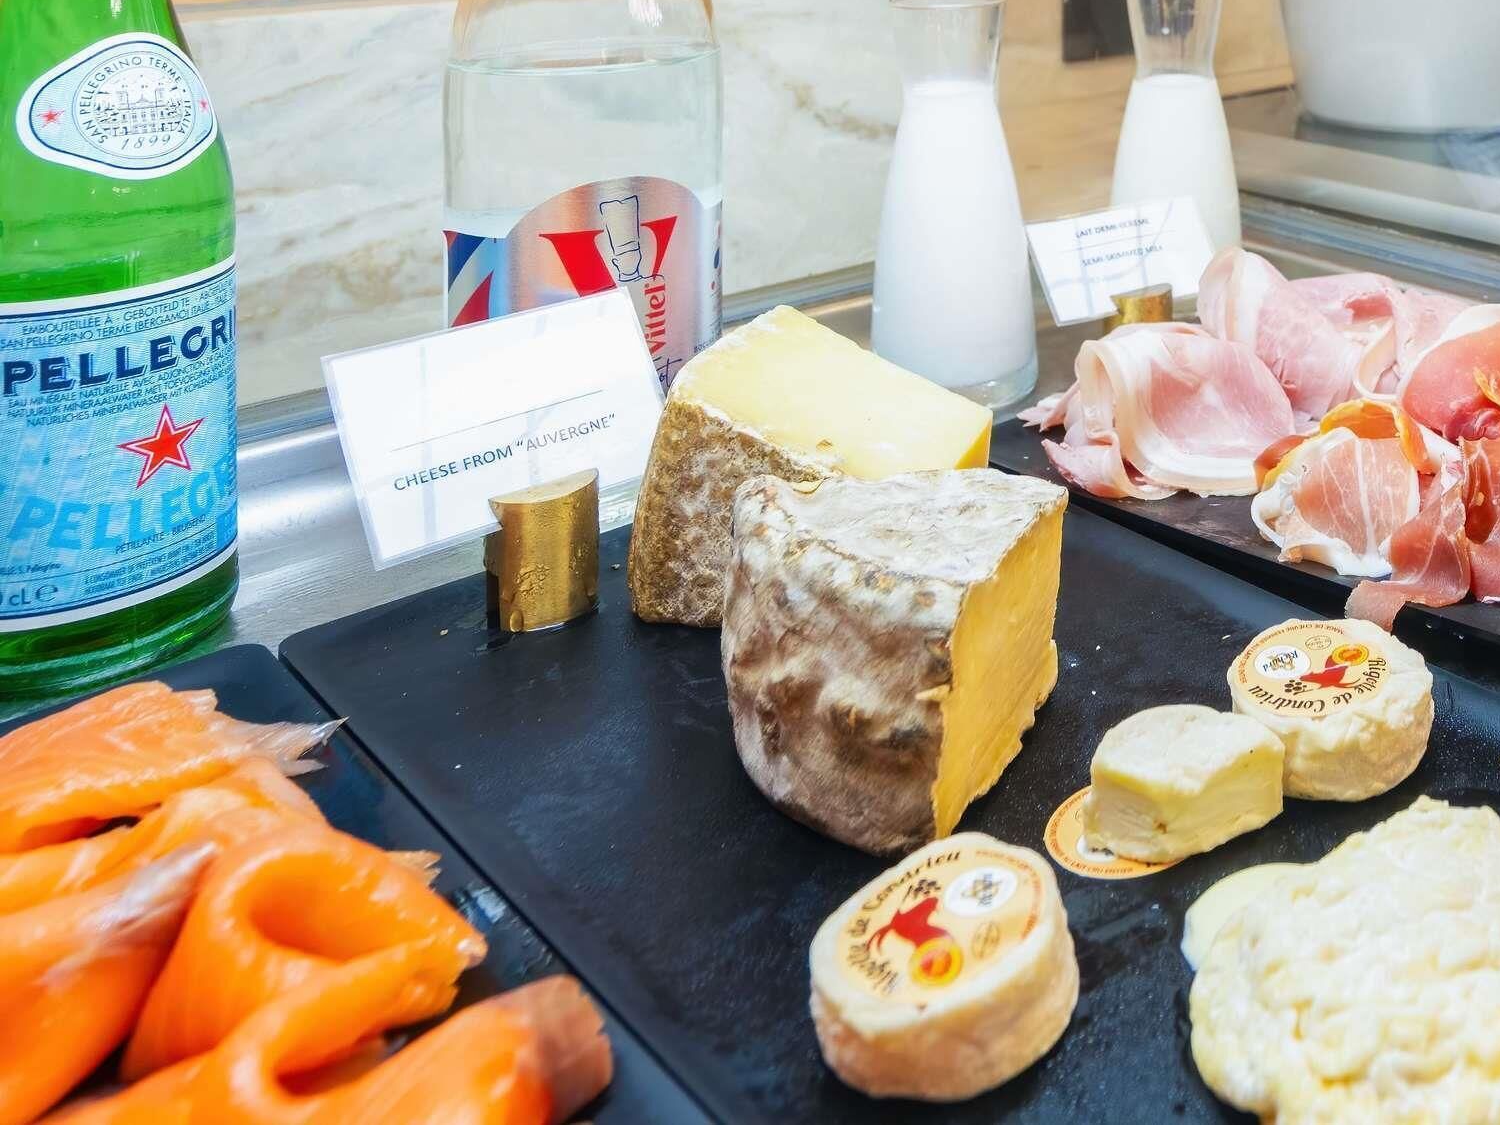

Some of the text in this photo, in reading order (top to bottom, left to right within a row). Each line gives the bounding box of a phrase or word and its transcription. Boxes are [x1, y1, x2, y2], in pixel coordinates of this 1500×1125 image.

[79, 56, 192, 144] SAN PELLEGRINO TERME ITALIA
[121, 134, 171, 151] 1899
[393, 460, 459, 492] CHEESE
[462, 443, 514, 472] FROM
[1248, 656, 1388, 713] Rigotte de Condrieu
